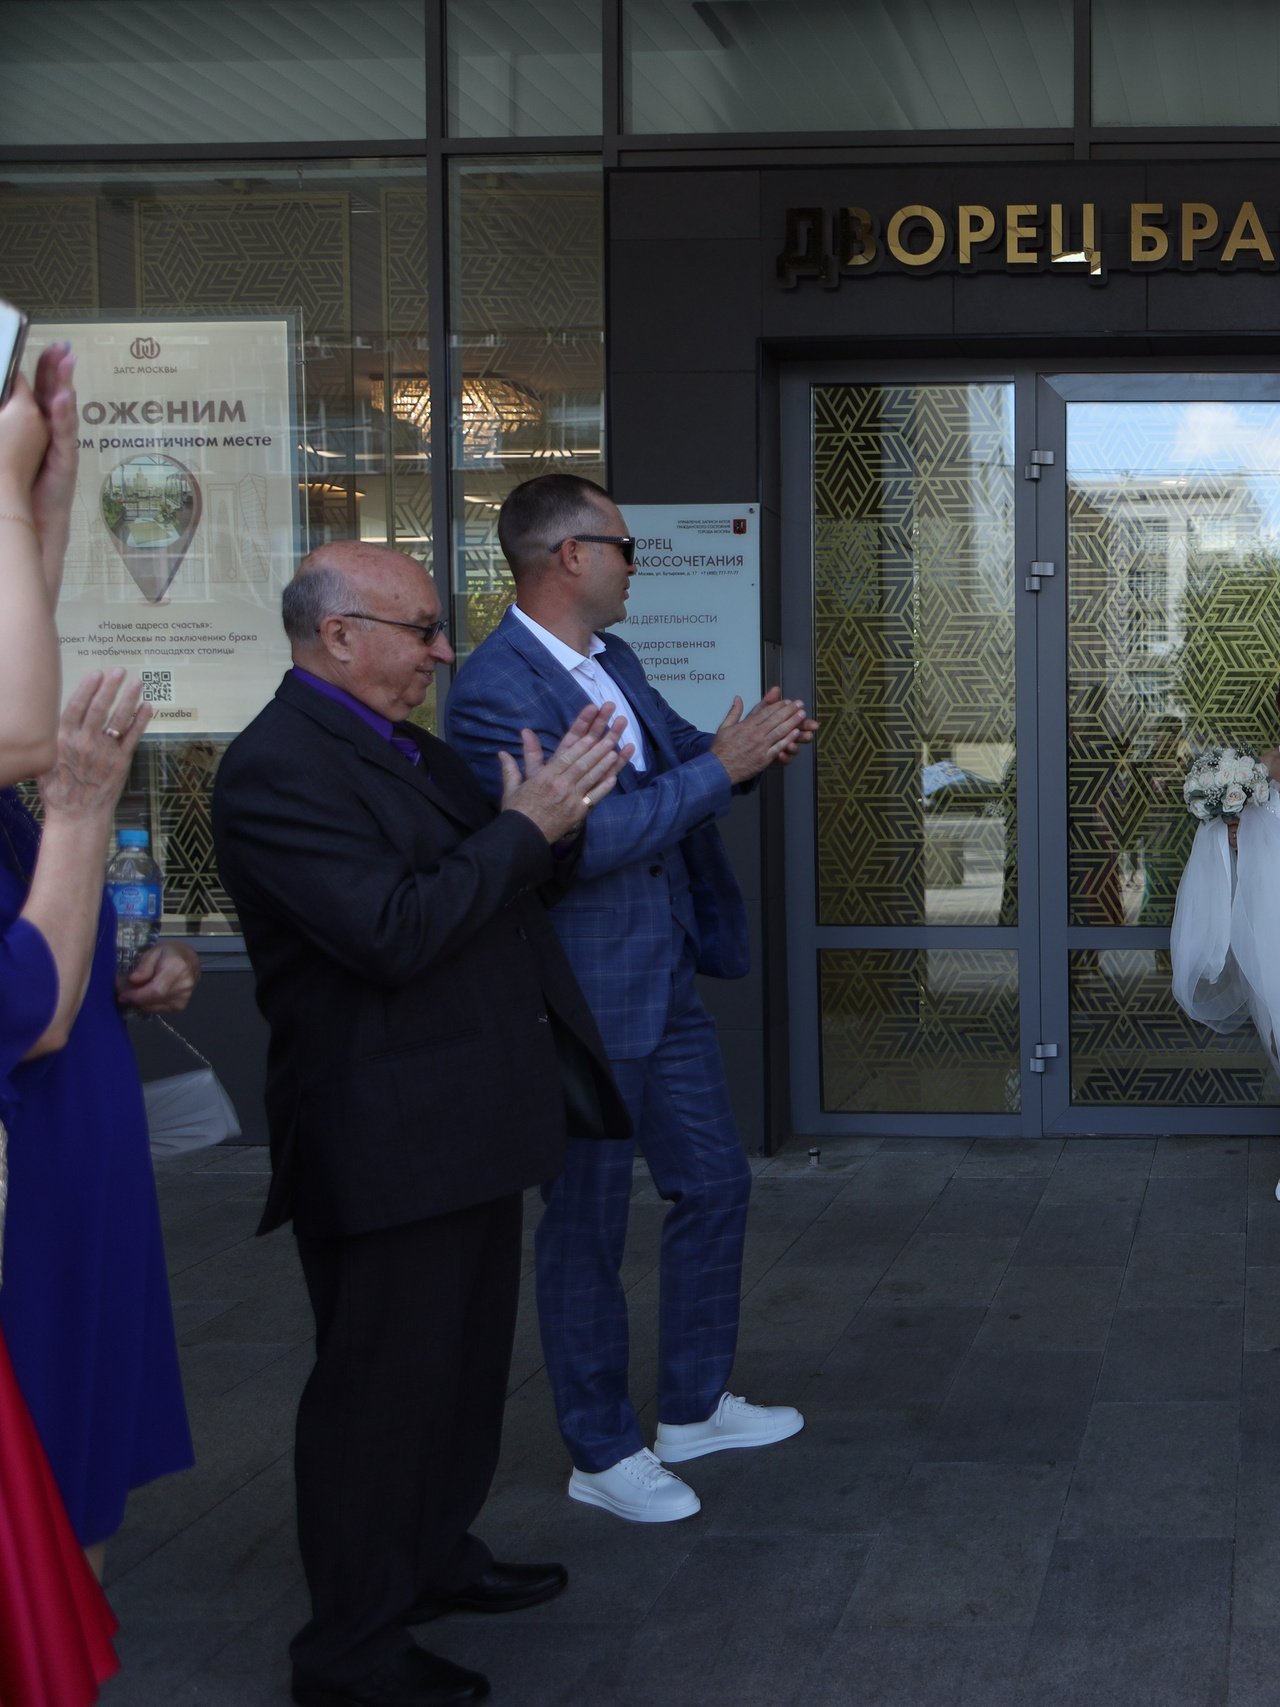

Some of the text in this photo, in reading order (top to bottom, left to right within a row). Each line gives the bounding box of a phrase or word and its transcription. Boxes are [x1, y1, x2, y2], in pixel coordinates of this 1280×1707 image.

[776, 203, 1101, 278] ДВОРЕЦ
[114, 366, 135, 374] ЗАГС
[82, 400, 246, 425] оженим
[100, 436, 218, 452] романтичном
[223, 435, 272, 446] месте
[636, 539, 672, 551] ОРЕЦ
[633, 555, 743, 567] АКОСОЧЕТАНИЯ
[641, 615, 717, 624] ДЕЯТЕЛЬНОСТИ
[99, 621, 133, 629] «Новые
[136, 622, 169, 632] адреса
[59, 636, 85, 646] роект
[88, 634, 114, 645] Мэра
[116, 633, 152, 643] Москвы
[228, 632, 257, 643] брака
[92, 647, 141, 656] необычных
[145, 647, 194, 656] площадках
[197, 647, 234, 656] столицы
[629, 641, 715, 651] сударственная
[689, 669, 725, 683] брака
